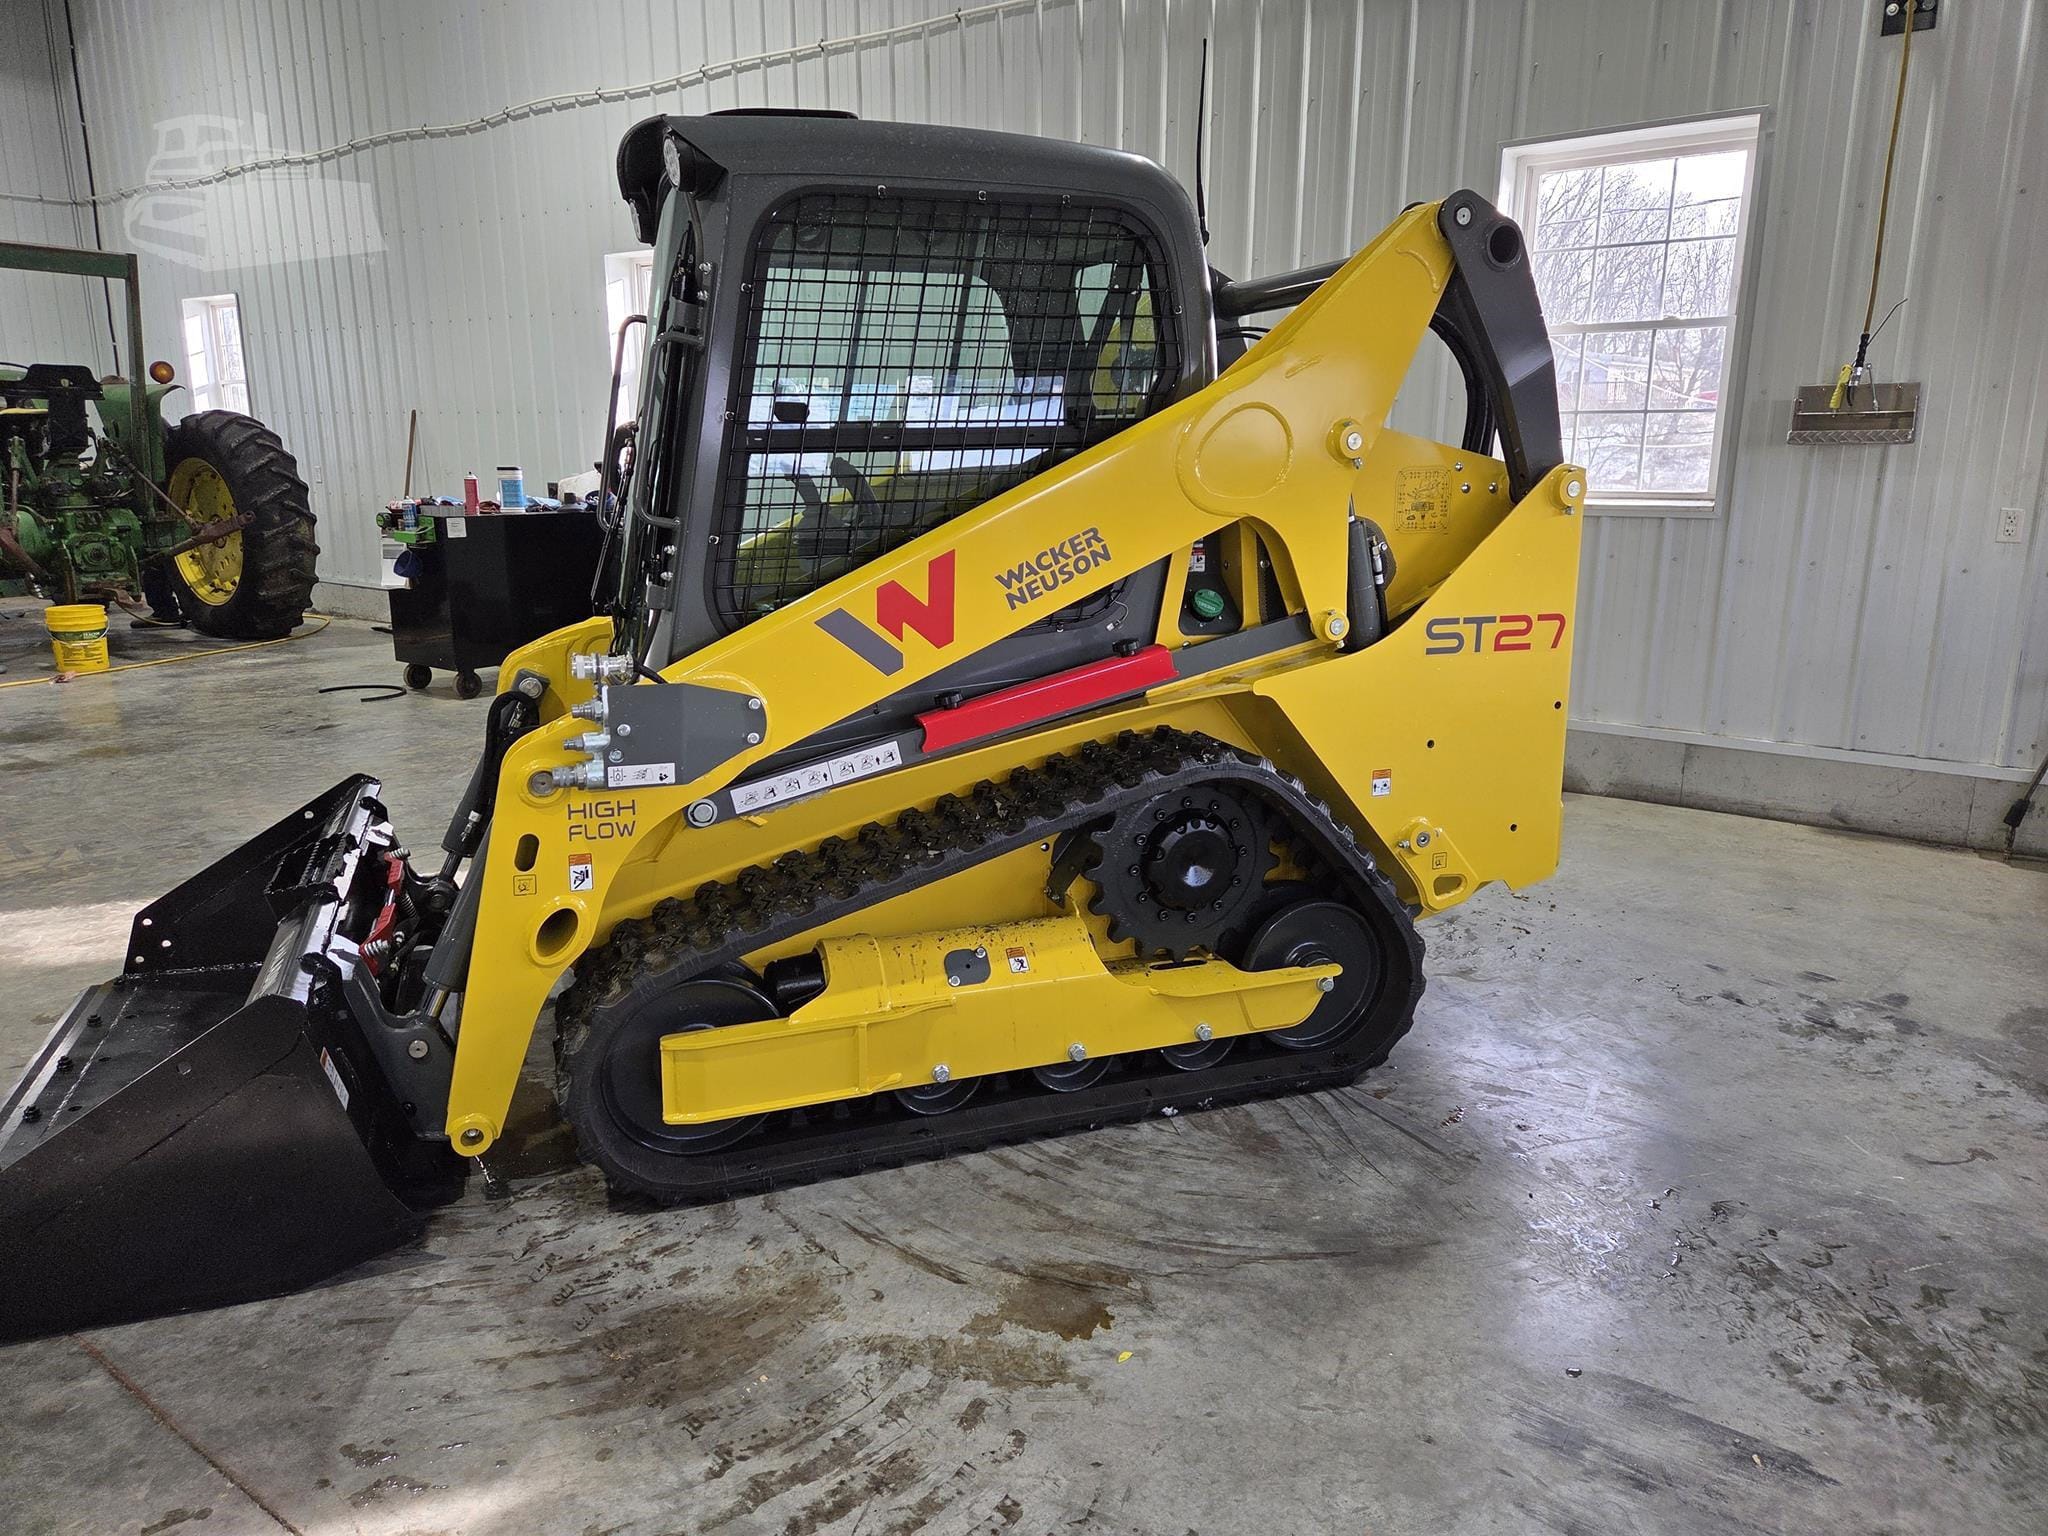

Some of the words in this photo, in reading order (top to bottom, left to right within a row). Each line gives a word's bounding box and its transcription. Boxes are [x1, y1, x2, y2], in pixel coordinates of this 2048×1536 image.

[994, 527, 1105, 590] WACKER
[1005, 543, 1112, 611] NEUSON
[1425, 613, 1566, 655] ST27
[567, 799, 636, 820] HIGH
[568, 820, 636, 842] FLOW
